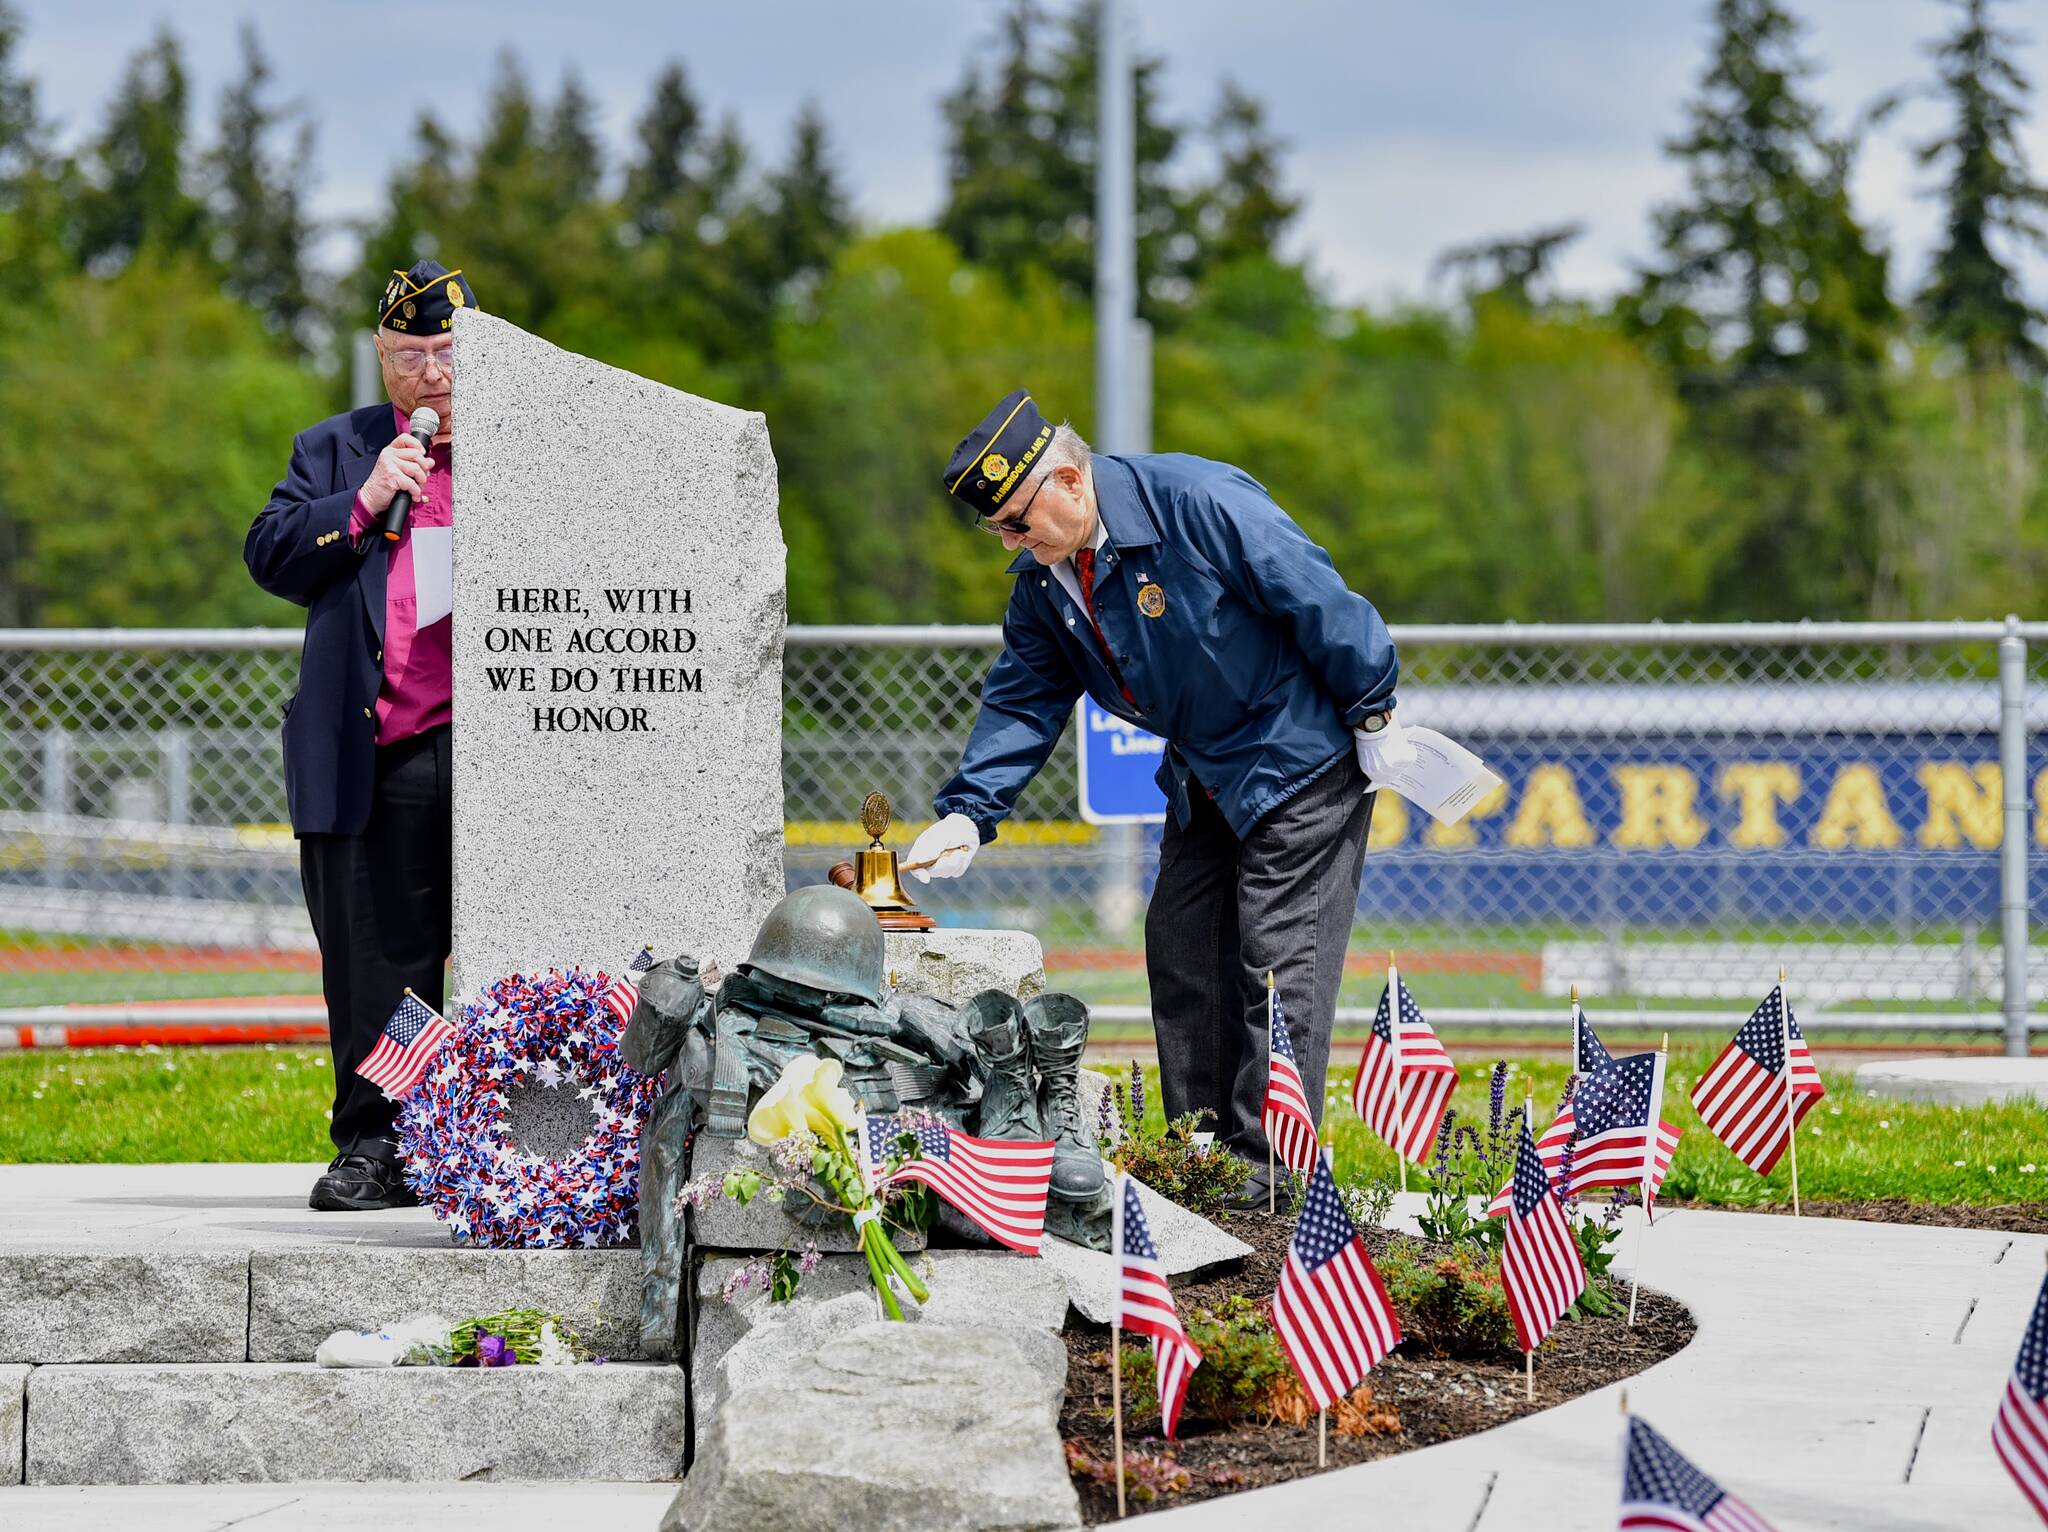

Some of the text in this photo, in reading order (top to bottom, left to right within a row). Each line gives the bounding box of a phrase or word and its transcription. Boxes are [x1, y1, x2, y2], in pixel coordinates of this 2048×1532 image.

[393, 318, 407, 330] 172
[992, 460, 1027, 504] BAINBRIDGE
[496, 588, 693, 619] HERE, WITH
[485, 627, 697, 653] ONE ACCORD
[485, 667, 703, 692] WE DO THEM
[532, 706, 657, 732] HONOR.
[1366, 760, 2048, 851] ARTAN
